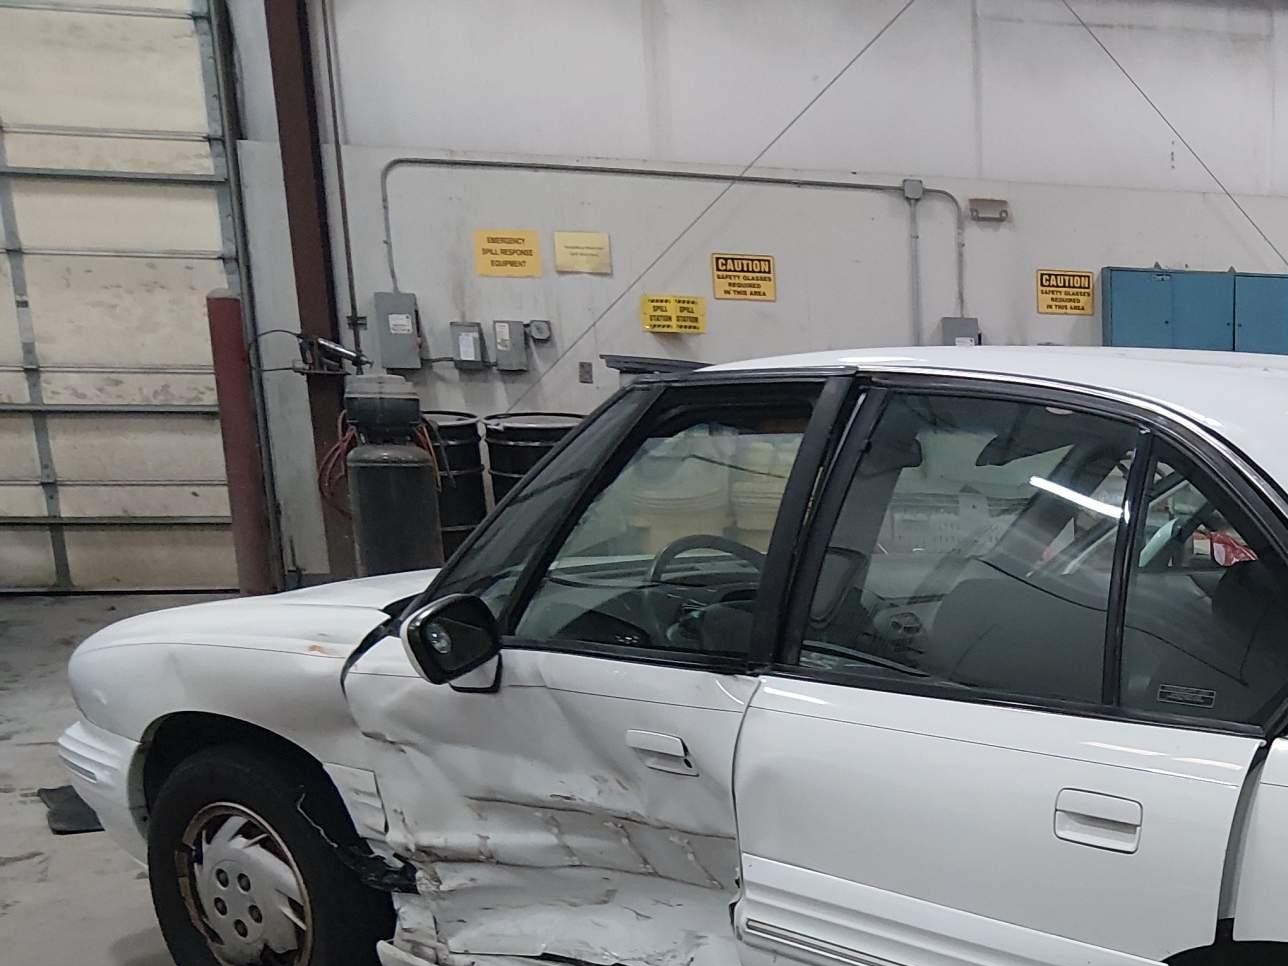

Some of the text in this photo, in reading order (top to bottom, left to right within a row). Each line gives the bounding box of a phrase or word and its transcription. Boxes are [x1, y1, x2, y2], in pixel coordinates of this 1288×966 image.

[487, 236, 525, 245] EMERGENCY
[482, 247, 533, 257] SPILL RESPONSE
[490, 259, 527, 268] EQUIPMENT
[717, 258, 770, 272] CAUTION
[717, 273, 772, 282] SAFETY GLASSES
[1042, 274, 1089, 288] CAUTION
[652, 305, 668, 313] SPILL
[679, 306, 695, 314] SPILL
[676, 315, 699, 323] STATION
